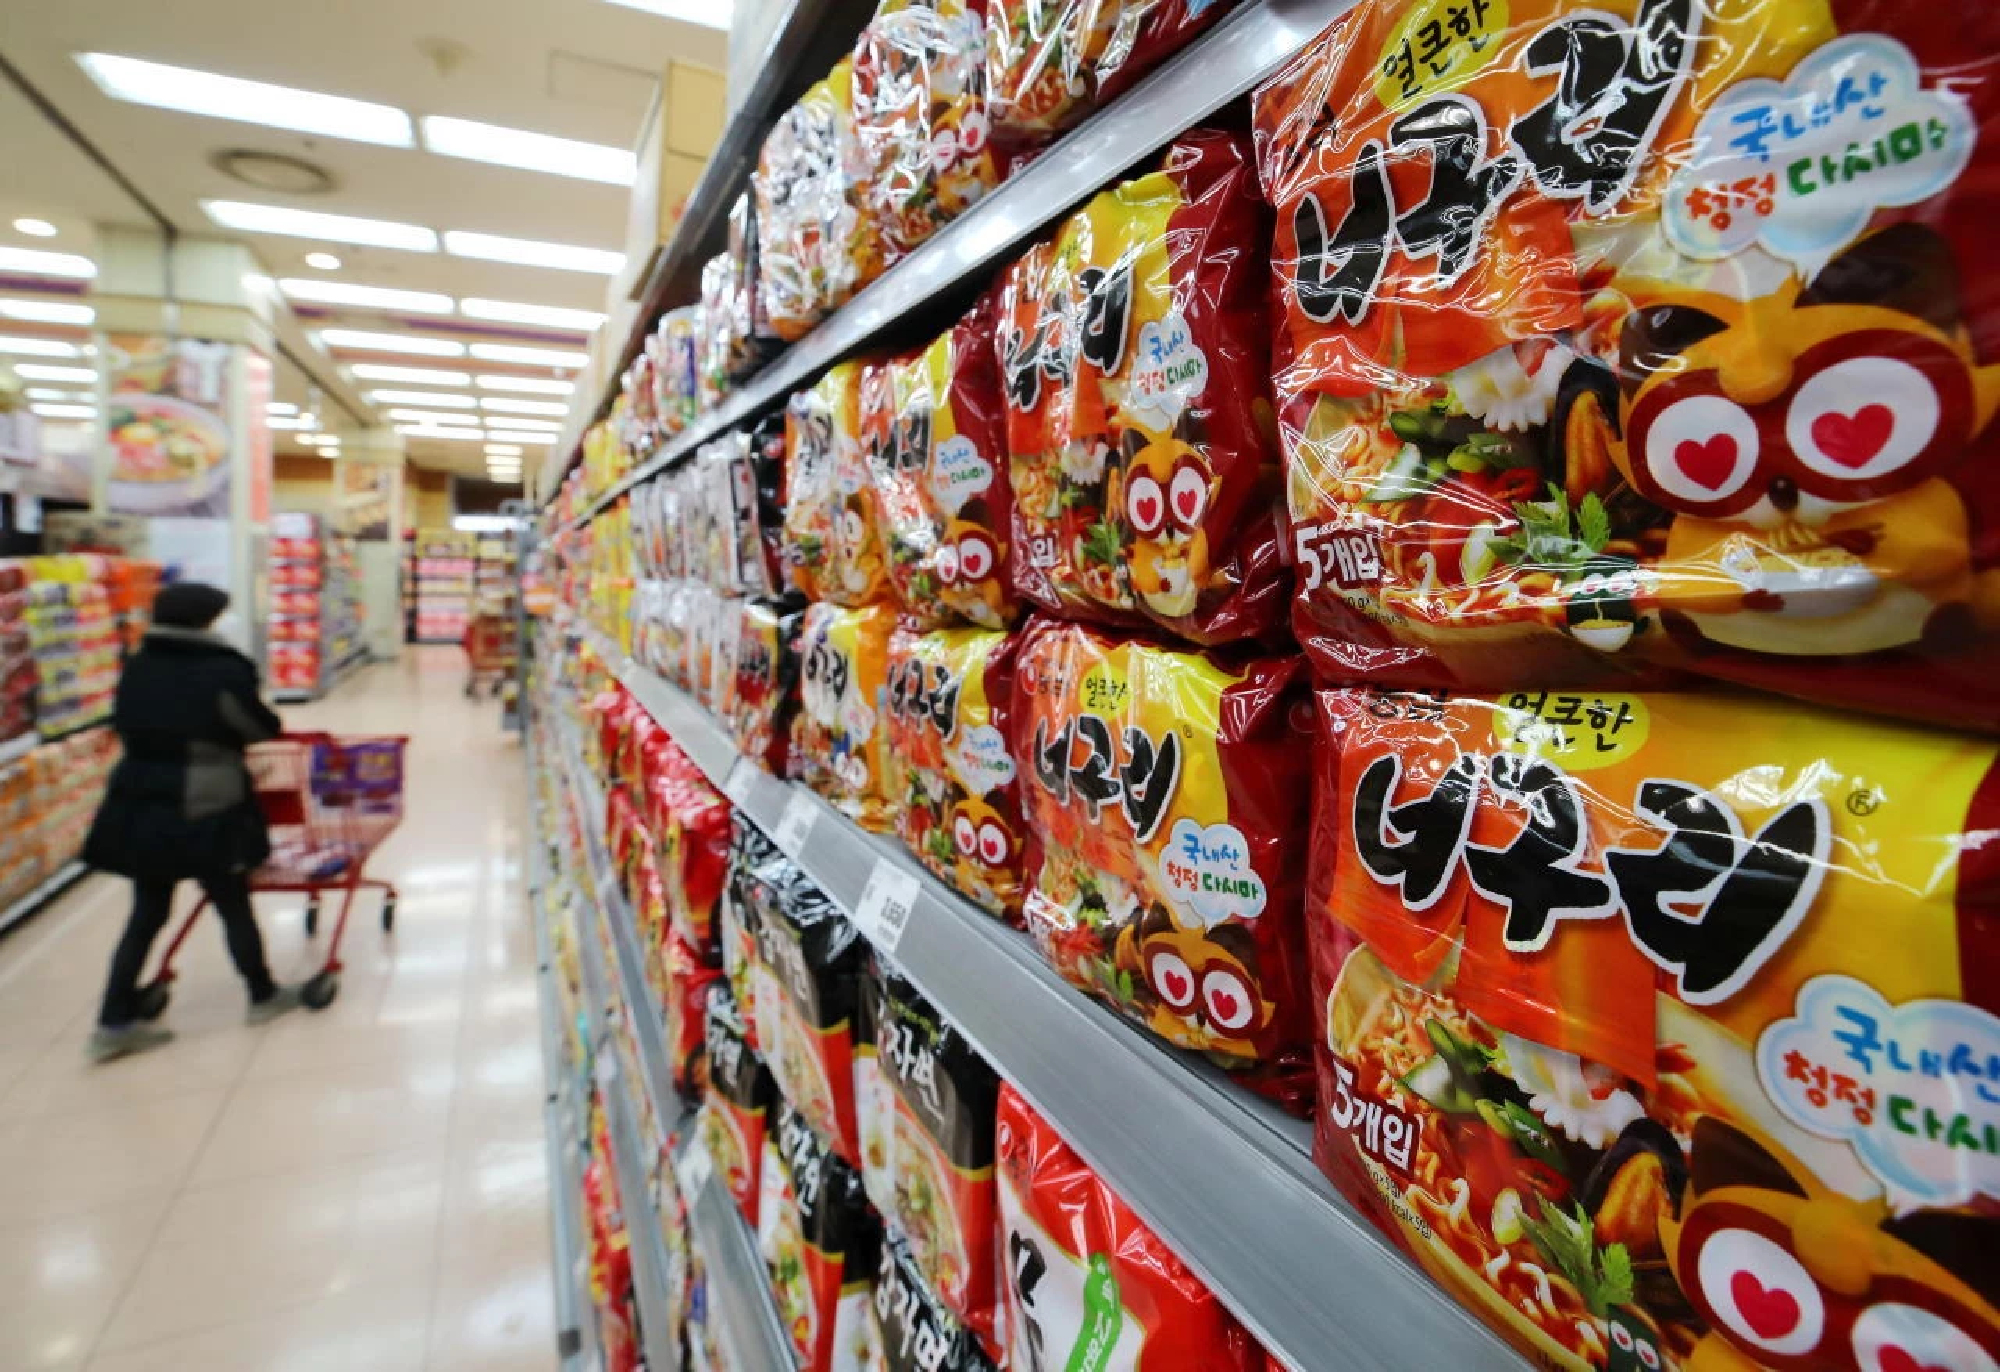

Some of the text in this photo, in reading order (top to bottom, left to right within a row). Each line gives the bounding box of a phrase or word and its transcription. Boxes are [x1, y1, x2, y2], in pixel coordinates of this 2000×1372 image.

[1382, 0, 1490, 99] 얼큰한
[1294, 0, 1706, 328] 너구리
[1729, 70, 1889, 163] 국내산
[1685, 116, 1948, 231] 청정 다시마
[1296, 526, 1381, 591] 5개입
[1032, 712, 1182, 846] 너구리
[1166, 860, 1259, 900] 청정 다시마
[1182, 832, 1241, 871] 국내산
[1353, 752, 1833, 1006] 너구리
[1783, 1050, 2000, 1156] 청정 다시
[1831, 1004, 2000, 1104] 국내산
[1331, 1060, 1414, 1171] 5개입
